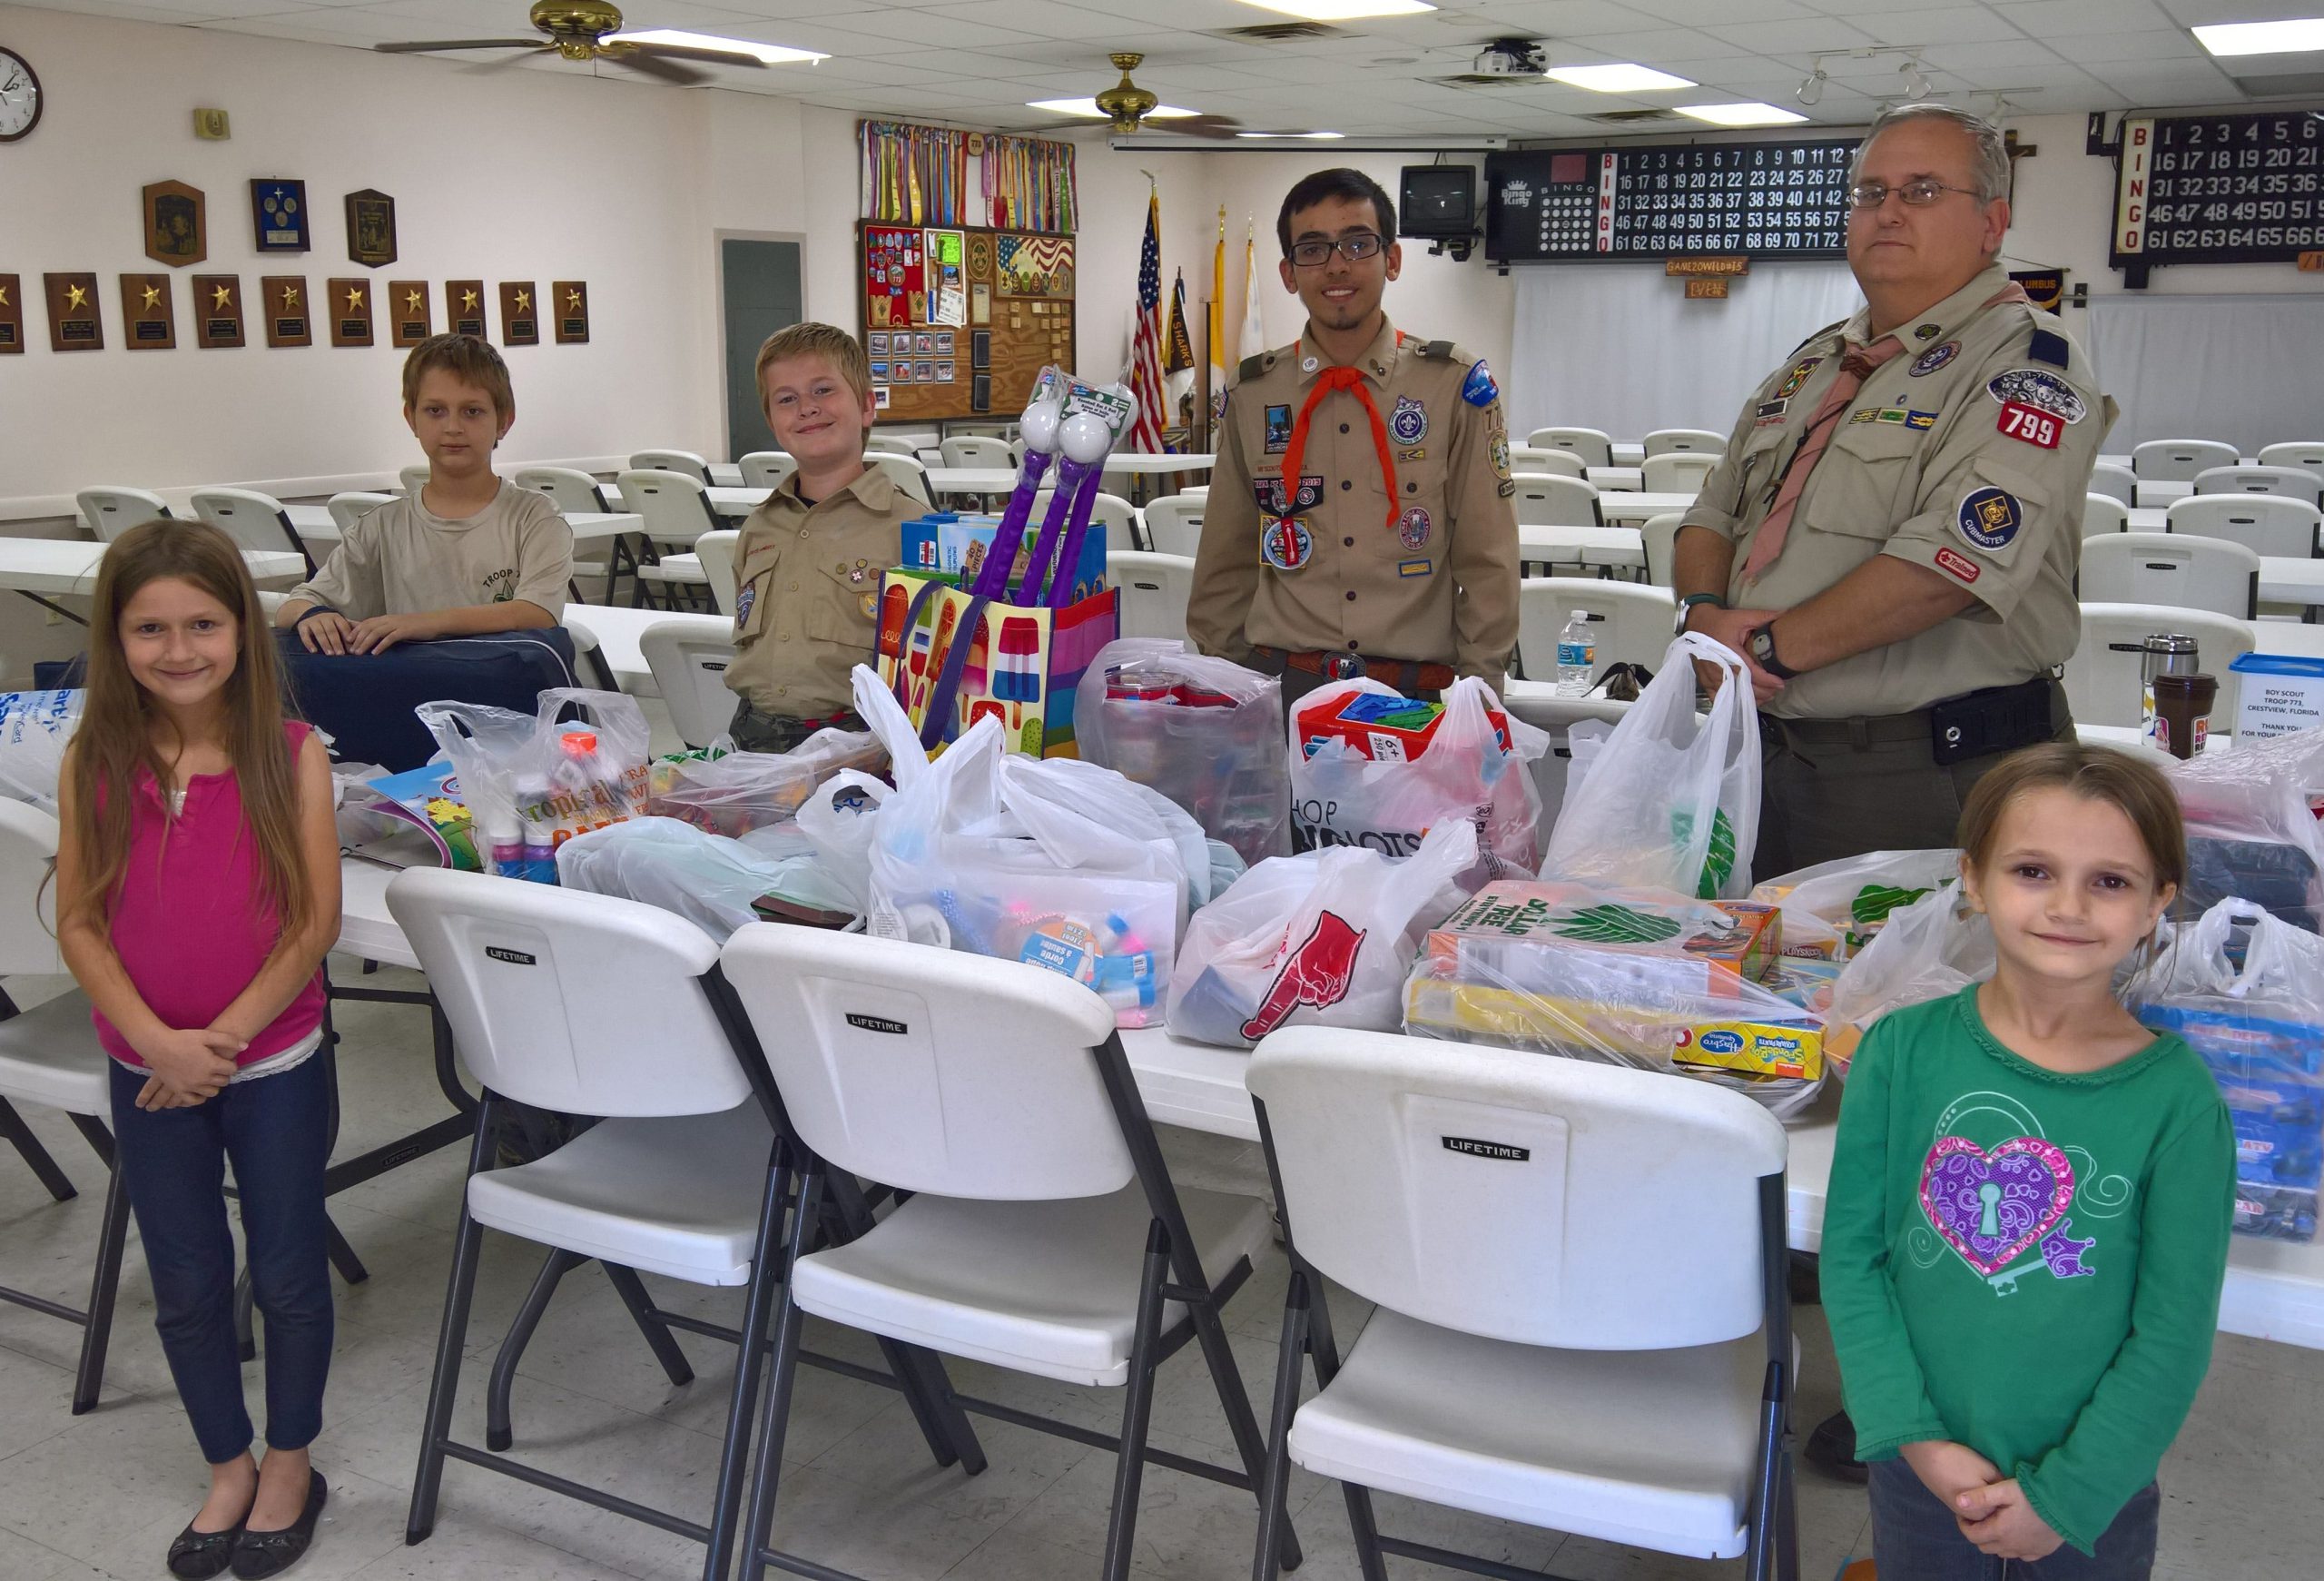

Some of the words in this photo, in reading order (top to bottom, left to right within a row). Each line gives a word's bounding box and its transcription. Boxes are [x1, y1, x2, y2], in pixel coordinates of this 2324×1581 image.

[2164, 126, 2171, 144] 1
[2189, 125, 2202, 143] 2
[2218, 124, 2230, 142] 3
[2246, 123, 2258, 141] 4
[2275, 122, 2289, 139] 5
[2303, 121, 2317, 138] 6
[1623, 155, 1629, 169] 1
[1641, 154, 1648, 169] 2
[1659, 154, 1666, 168] 3
[1677, 153, 1684, 167] 4
[1696, 153, 1702, 167] 5
[1714, 153, 1721, 166] 6
[1734, 152, 1740, 166] 7
[1756, 151, 1763, 165] 8
[1775, 150, 1782, 164] 9
[1791, 149, 1805, 164] 10
[1811, 149, 1824, 163] 11
[1830, 148, 1844, 163] 12
[2154, 153, 2175, 171] 16
[2182, 152, 2204, 170] 17
[2209, 151, 2230, 169] 18
[2238, 150, 2259, 168] 19
[2265, 149, 2290, 167] 20
[2296, 147, 2317, 165] 21
[1620, 175, 1631, 189] 16
[1638, 175, 1649, 189] 17
[1656, 174, 1668, 189] 18
[1674, 174, 1686, 188] 19
[1690, 173, 1705, 187] 20
[1709, 173, 1723, 187] 21
[1728, 173, 1742, 187] 22
[1750, 171, 1765, 185] 23
[1769, 171, 1784, 185] 24
[1788, 170, 1804, 185] 25
[1807, 170, 1823, 184] 26
[1827, 169, 1843, 183] 27
[2153, 179, 2171, 196] 31
[2179, 178, 2201, 196] 32
[2206, 177, 2230, 195] 33
[2235, 176, 2259, 194] 34
[2263, 175, 2289, 193] 35
[2292, 174, 2317, 192] 36
[1502, 188, 1532, 198] Bingo
[1503, 196, 1530, 208] King
[1618, 195, 1630, 210] 31
[1635, 195, 1649, 209] 32
[1653, 194, 1667, 209] 33
[1671, 194, 1685, 208] 34
[1689, 193, 1704, 208] 35
[1708, 193, 1723, 208] 36
[1727, 193, 1741, 208] 37
[1748, 192, 1764, 207] 38
[1768, 192, 1783, 206] 39
[1787, 191, 1802, 206] 40
[1807, 191, 1821, 205] 41
[1826, 190, 1841, 205] 42
[1616, 215, 1630, 229] 46
[1634, 215, 1648, 229] 47
[1652, 214, 1666, 229] 48
[1670, 214, 1685, 228] 49
[1689, 214, 1703, 228] 50
[1708, 213, 1720, 228] 51
[1726, 213, 1740, 228] 52
[1748, 212, 1762, 227] 53
[1767, 212, 1781, 227] 54
[1786, 212, 1801, 227] 55
[1805, 212, 1820, 227] 56
[1825, 212, 1840, 226] 57
[2149, 205, 2173, 222] 46
[2175, 204, 2200, 222] 47
[2204, 203, 2228, 221] 48
[2232, 203, 2256, 220] 49
[2260, 202, 2285, 220] 50
[2290, 201, 2310, 219] 51
[1616, 236, 1629, 250] 61
[1633, 236, 1647, 250] 62
[1651, 235, 1665, 250] 63
[1669, 235, 1683, 250] 64
[1688, 234, 1702, 249] 65
[1706, 234, 1720, 249] 66
[1725, 234, 1739, 249] 67
[1747, 233, 1761, 248] 68
[1766, 232, 1780, 248] 69
[1785, 232, 1799, 247] 70
[1805, 232, 1818, 247] 71
[1823, 232, 1838, 247] 72
[2149, 231, 2168, 248] 61
[2173, 231, 2196, 248] 62
[2201, 230, 2225, 247] 63
[2229, 229, 2253, 246] 64
[2257, 228, 2282, 245] 65
[2286, 227, 2310, 244] 66
[1173, 321, 1193, 367] SHARKS
[2005, 408, 2054, 445] 799
[1965, 519, 2005, 545] CUBMASTER
[972, 543, 985, 569] PIECES
[1949, 557, 1976, 577] Trained
[483, 568, 513, 588] TROOP
[2248, 705, 2288, 714] CRESTVIEW,
[1477, 904, 1521, 927] TREE
[1501, 898, 1550, 935] DOLLAR
[490, 949, 530, 963] LIFETIME
[1040, 950, 1065, 966] Corde
[852, 1016, 902, 1032] LIFETIME
[1703, 1039, 1738, 1052] Hasbro
[1450, 1140, 1521, 1159] LIFETIME
[2243, 1141, 2271, 1152] ATV
